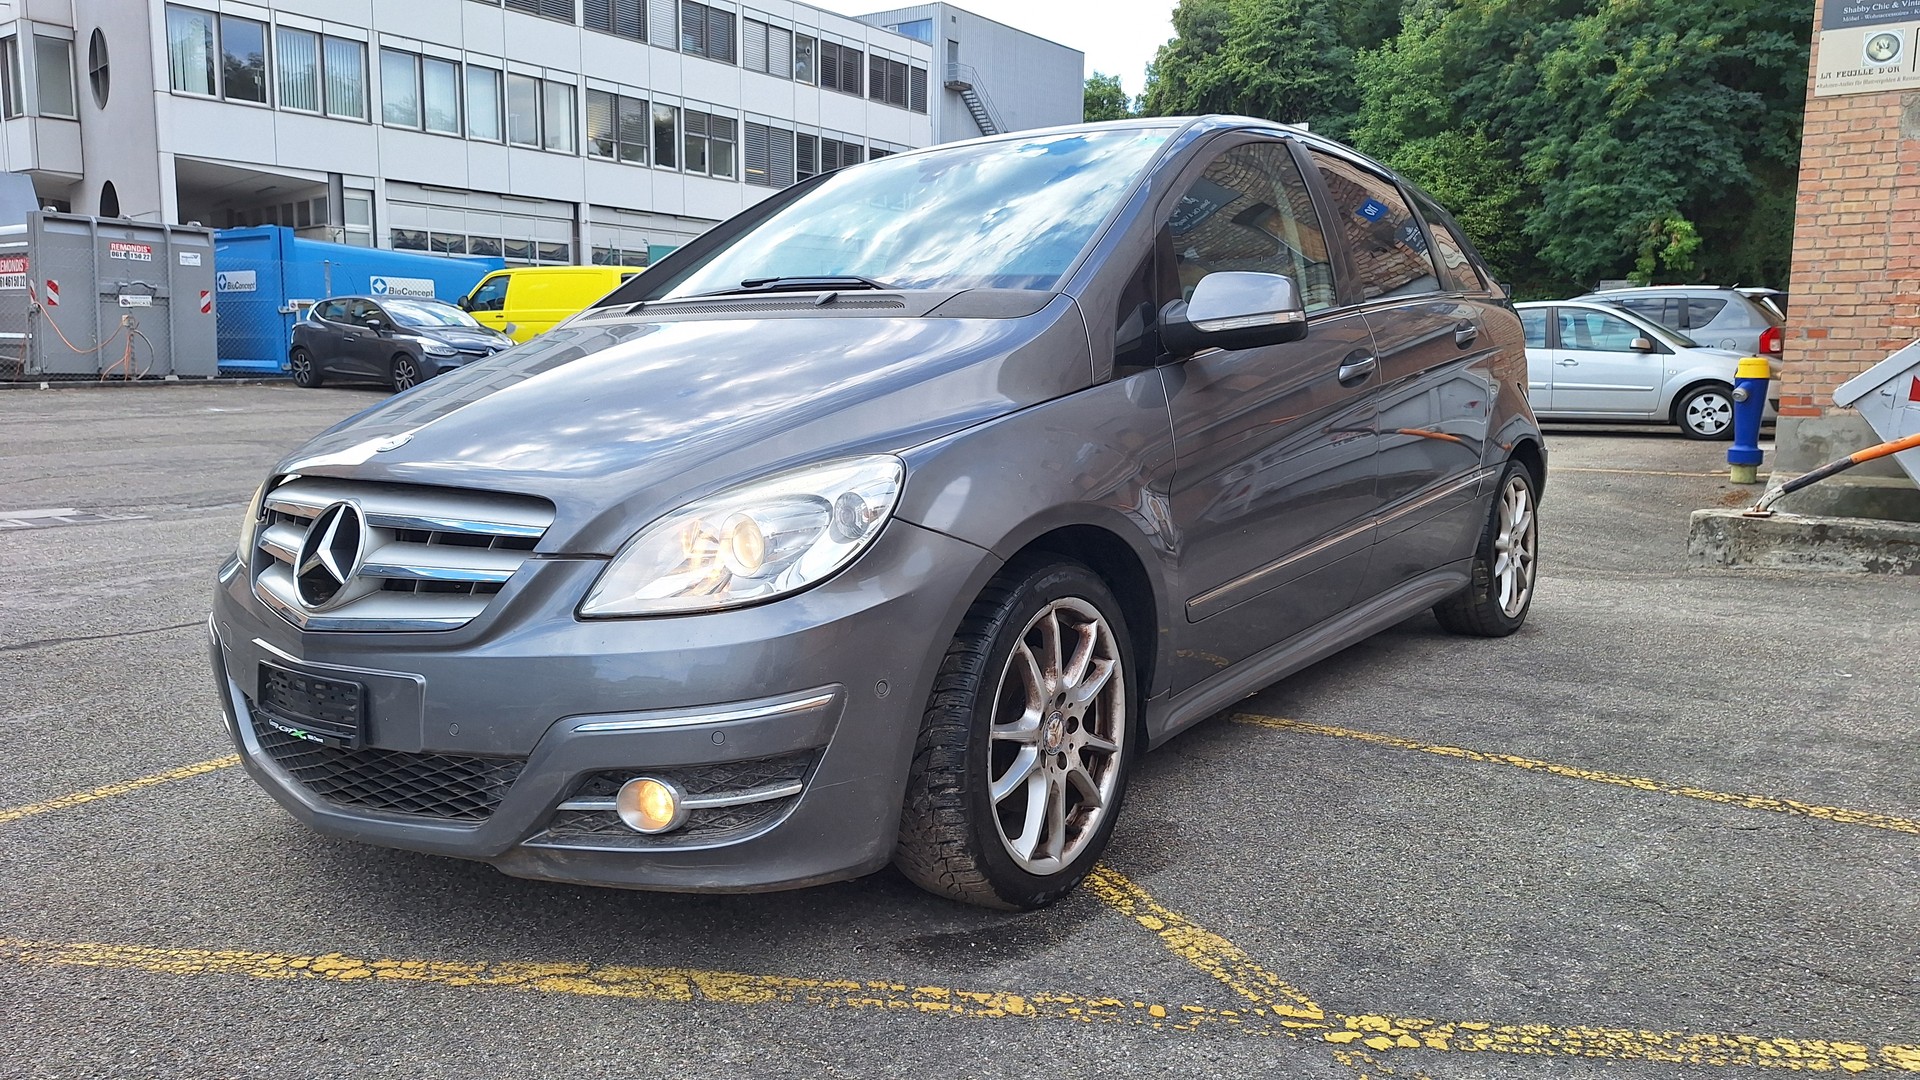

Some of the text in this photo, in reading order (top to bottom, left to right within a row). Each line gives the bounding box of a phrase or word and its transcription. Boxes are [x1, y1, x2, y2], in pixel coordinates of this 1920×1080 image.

[1843, 5, 1870, 14] Shabby
[1872, 2, 1890, 11] Chic
[1891, 1, 1900, 9] &
[1836, 68, 1874, 78] FEUILLE
[111, 243, 148, 253] REMONDIS
[227, 281, 255, 290] BioConcept
[388, 286, 434, 298] BioConcept
